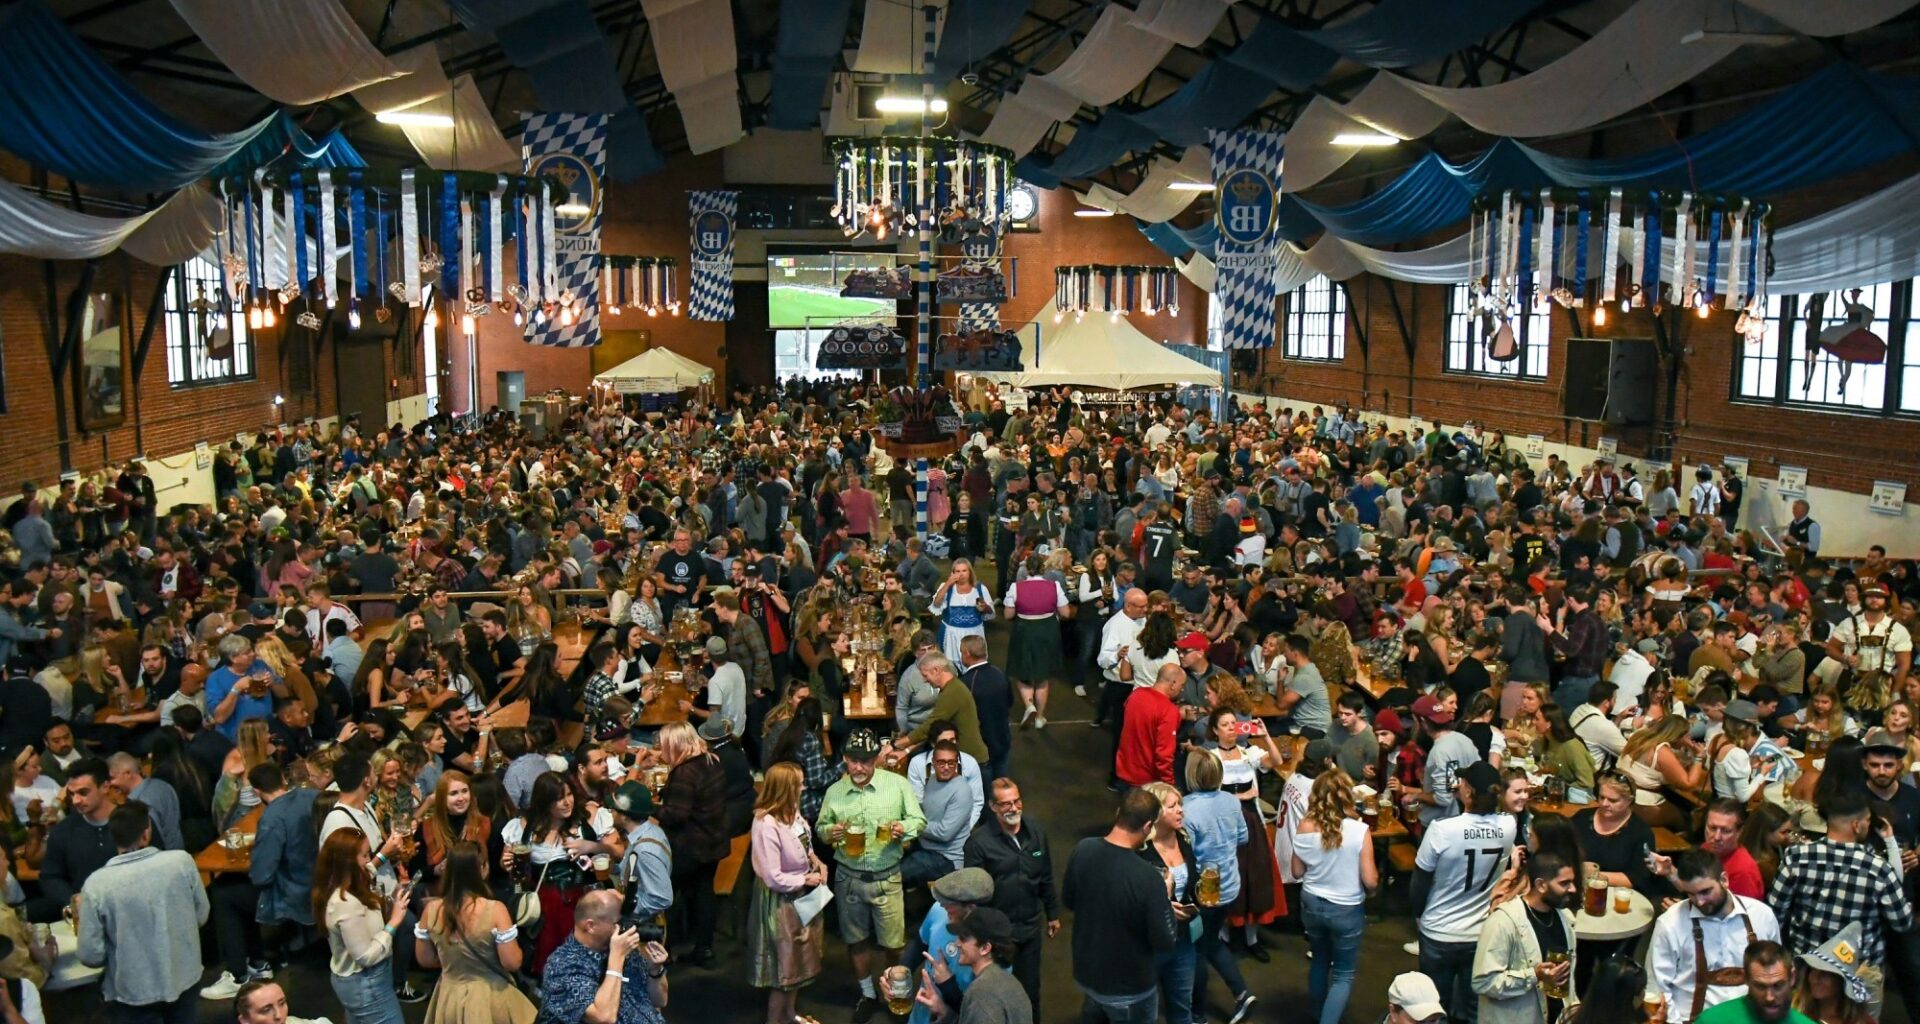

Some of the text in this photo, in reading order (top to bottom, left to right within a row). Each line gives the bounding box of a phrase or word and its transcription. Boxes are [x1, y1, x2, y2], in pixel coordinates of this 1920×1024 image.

[1152, 535, 1163, 557] 7
[752, 608, 763, 618] 07
[1464, 828, 1504, 840] BOATENG
[1464, 848, 1504, 892] 17
